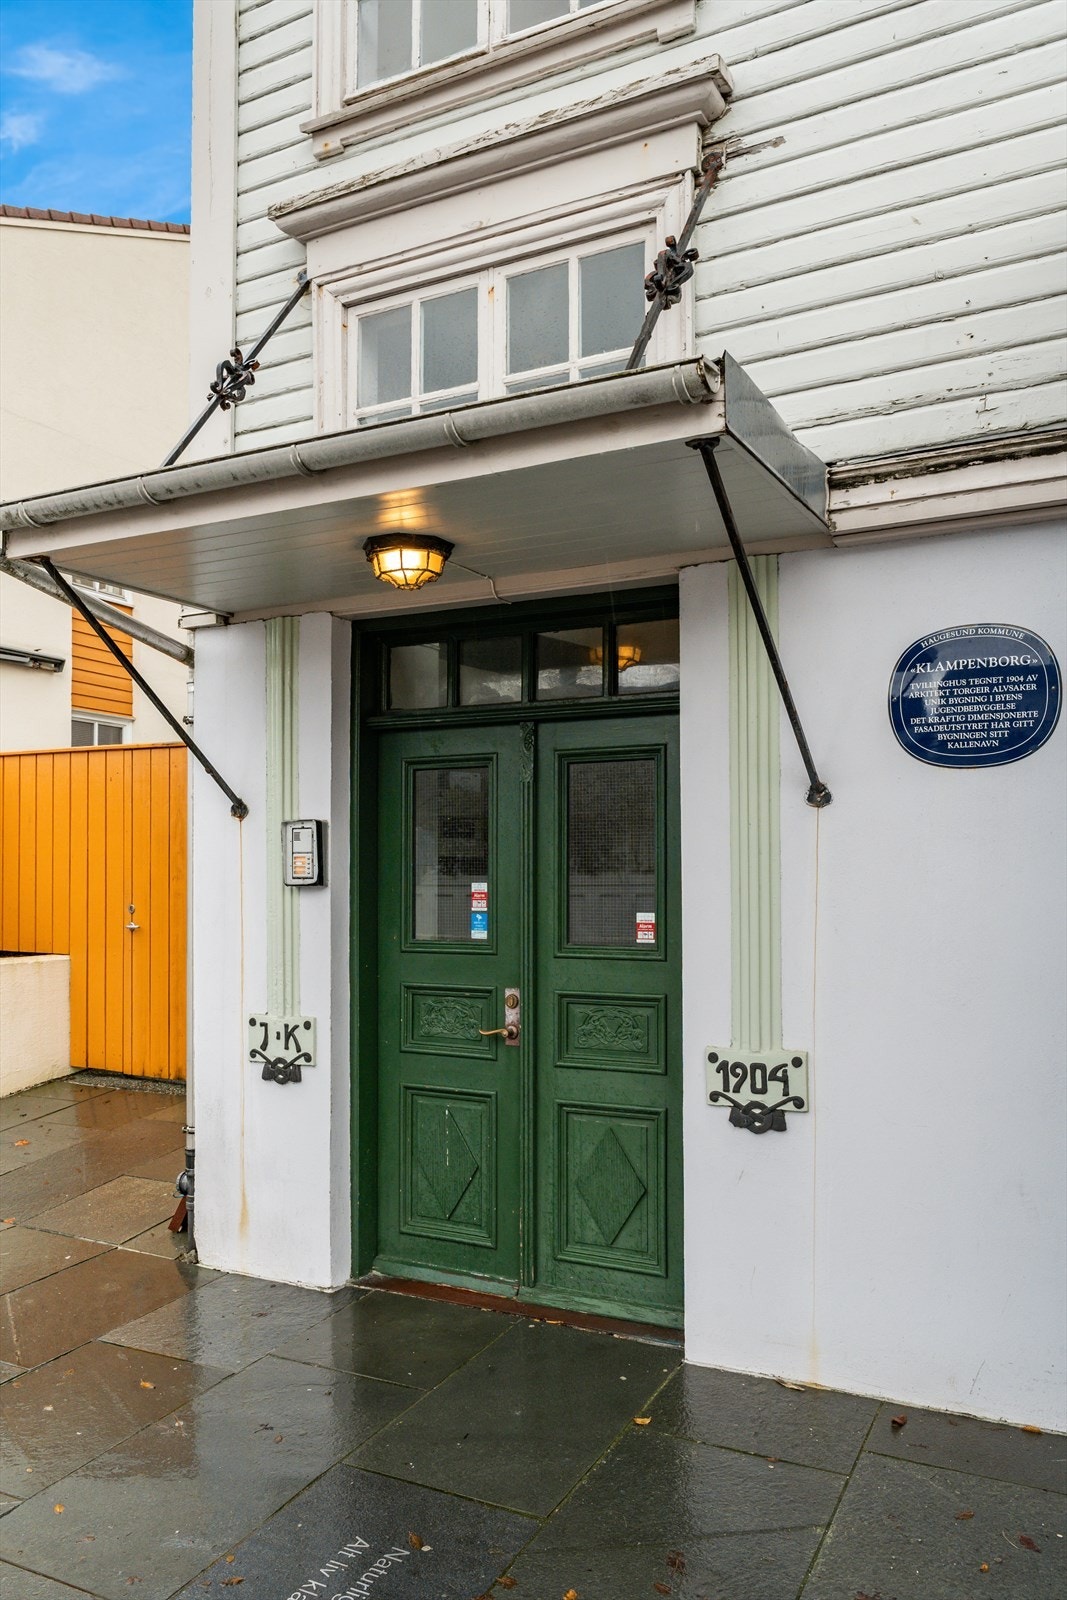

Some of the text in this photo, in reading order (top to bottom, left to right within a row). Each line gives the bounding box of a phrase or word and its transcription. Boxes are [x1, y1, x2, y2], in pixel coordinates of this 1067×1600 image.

[921, 627, 1026, 648] HAUGESUND KOMMUNE
[910, 654, 1038, 674] «KLAMPENBORG»
[910, 674, 1038, 690] TVILLINGHUS TEGNET 1904 AV
[909, 684, 1037, 699] ARKITEKT TORGEIR ALVSAKER
[925, 698, 947, 706] UNIK
[948, 695, 987, 704] BYGNING
[995, 693, 1023, 702] BYENS
[930, 703, 1016, 715] JUGENDBEBYGGELSE
[910, 711, 1039, 725] DET KRAFTIG DIMENSJONERTE
[914, 719, 1035, 733] FASADEUTSTYRET HAR GITT
[937, 730, 1010, 741] BYGNINGEN SITT
[947, 739, 999, 749] KALLENAVN
[715, 1059, 789, 1096] 1904
[337, 1535, 370, 1558] Alt
[319, 1559, 348, 1578] liv
